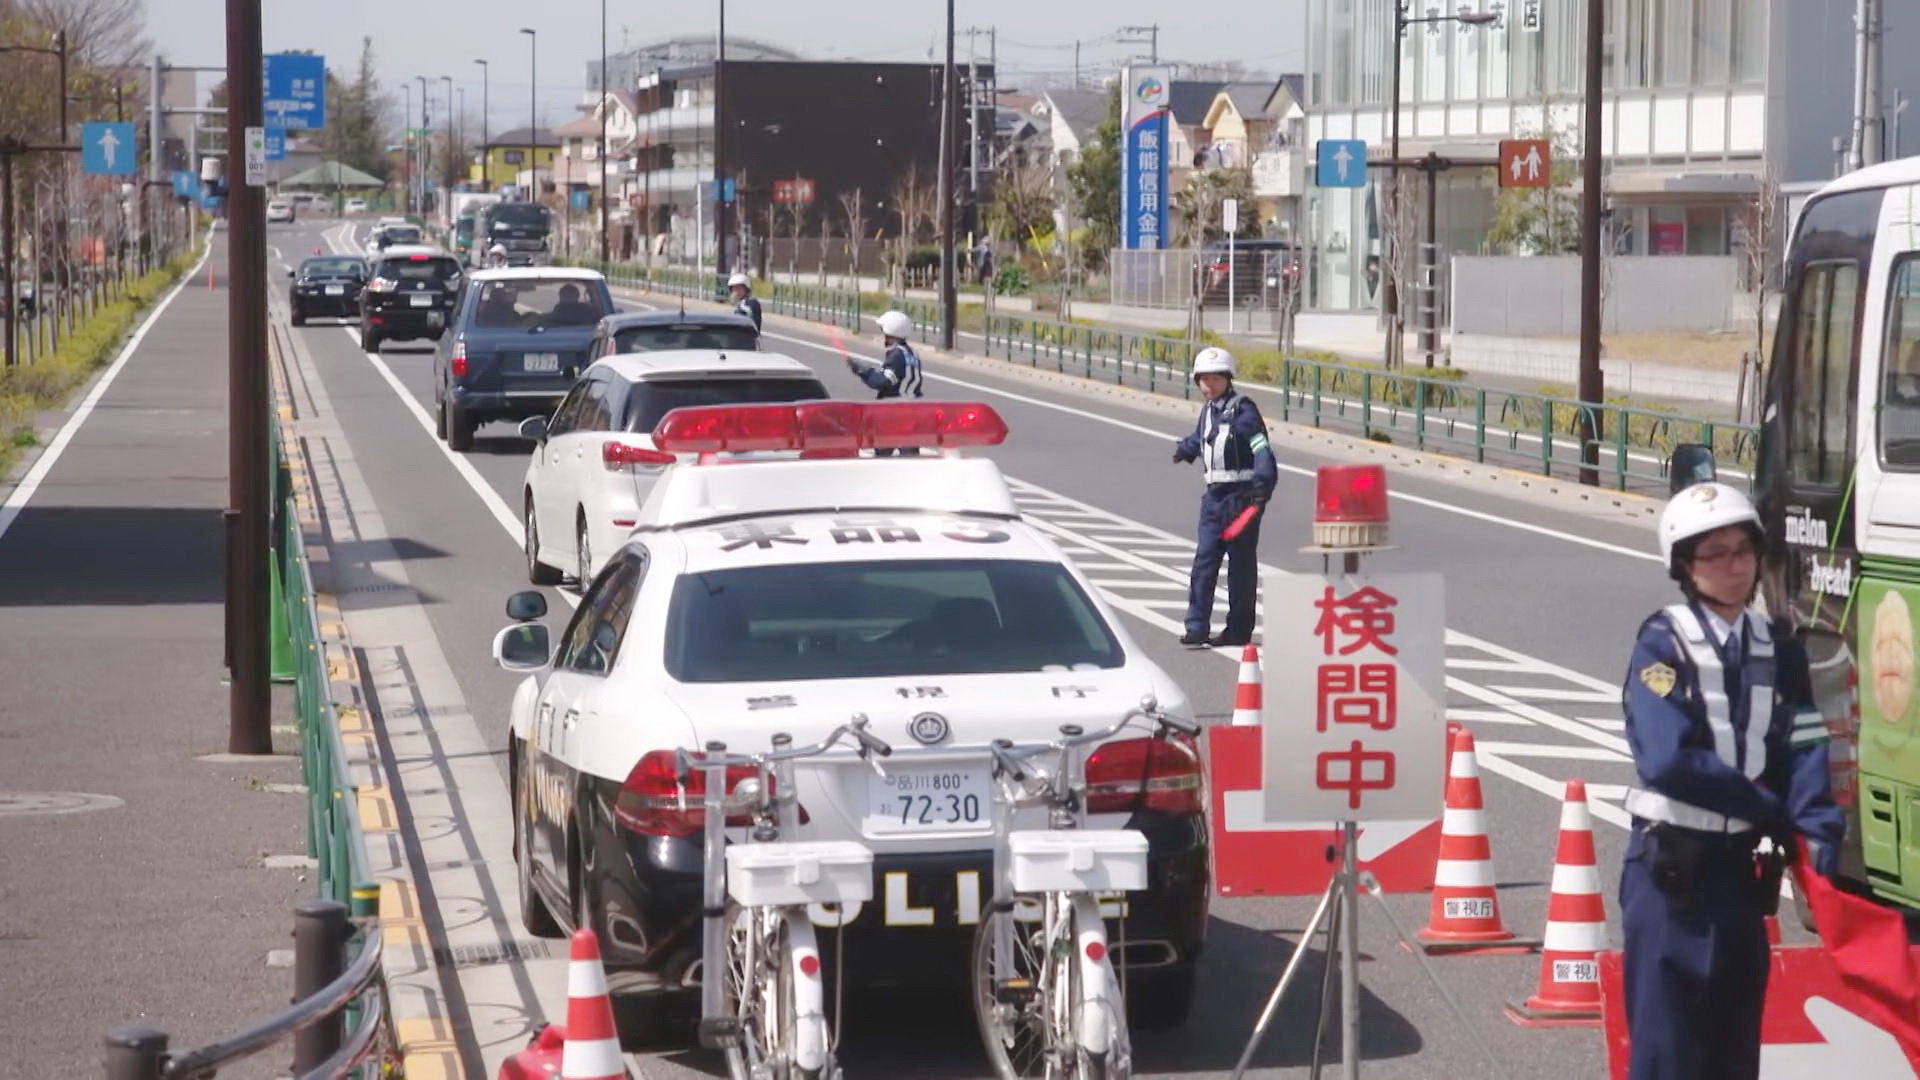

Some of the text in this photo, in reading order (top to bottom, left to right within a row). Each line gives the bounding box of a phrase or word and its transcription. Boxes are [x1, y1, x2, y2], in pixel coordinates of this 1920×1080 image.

[1785, 507, 1828, 548] melon
[1810, 553, 1852, 597] bread
[1314, 586, 1398, 810] 検問中
[898, 774, 961, 790] 品川 800
[1446, 901, 1491, 917] 警視庁
